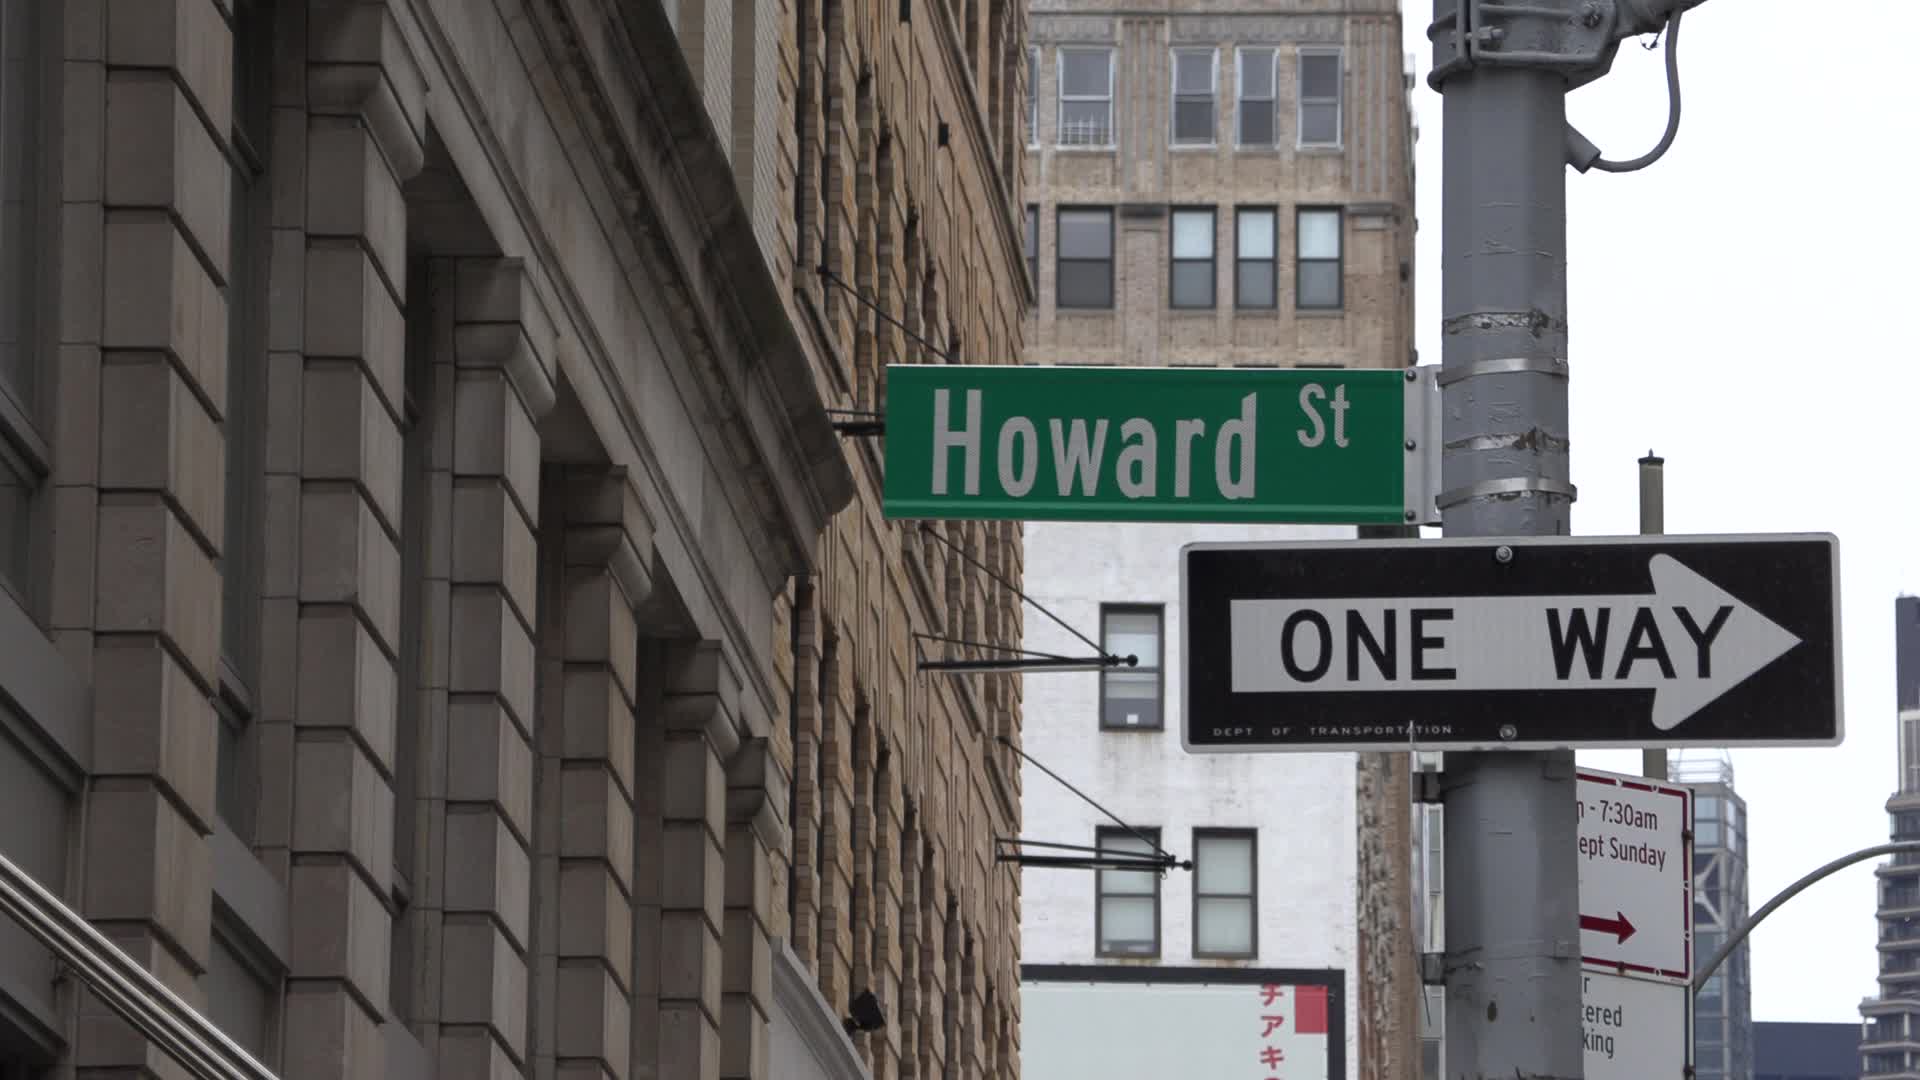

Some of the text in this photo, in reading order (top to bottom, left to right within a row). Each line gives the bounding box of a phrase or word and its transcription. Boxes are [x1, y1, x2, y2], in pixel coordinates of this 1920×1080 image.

[931, 383, 1351, 500] Howard St
[1280, 605, 1735, 683] ONE WAY
[1213, 725, 1452, 737] DEPT OF TRANSPORTATION
[1600, 799, 1658, 831] 7:30am
[1609, 836, 1666, 872] Sunday
[1260, 983, 1284, 1080] チアキ
[1582, 1004, 1622, 1028] ered
